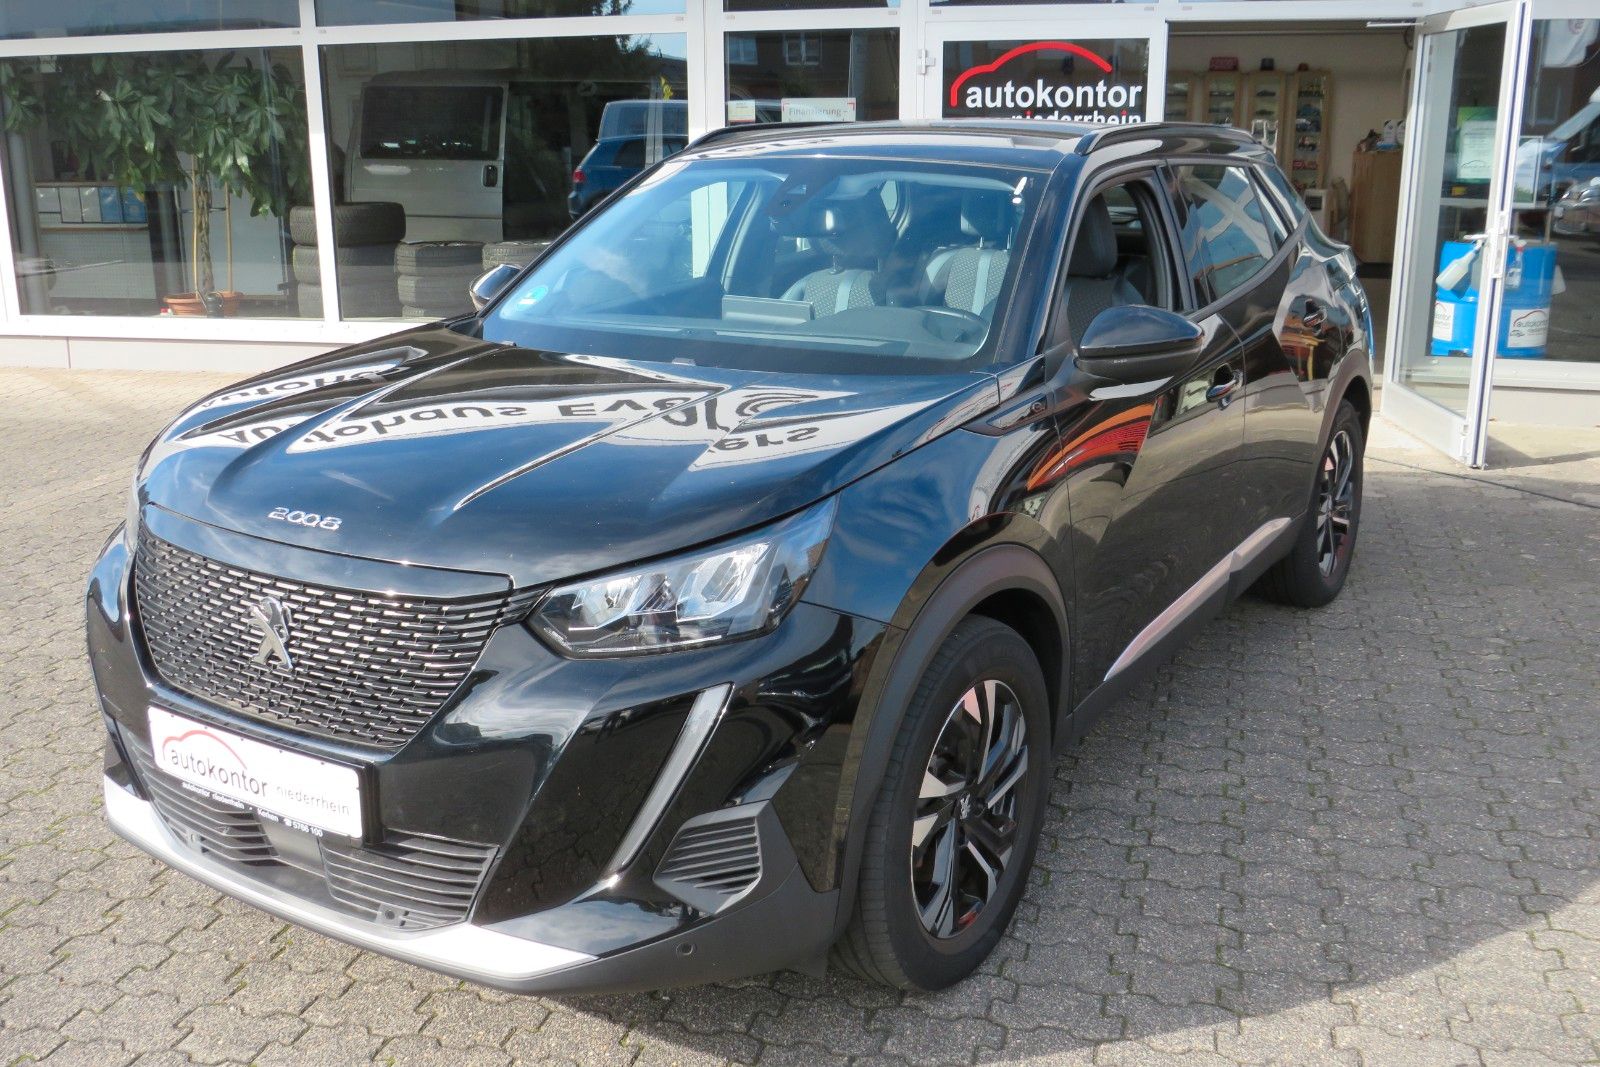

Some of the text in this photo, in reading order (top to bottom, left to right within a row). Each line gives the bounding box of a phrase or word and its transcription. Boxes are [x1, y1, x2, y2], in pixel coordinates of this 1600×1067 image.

[965, 78, 1143, 109] autokontor
[267, 506, 343, 531] 2008
[170, 748, 268, 798] autokontor
